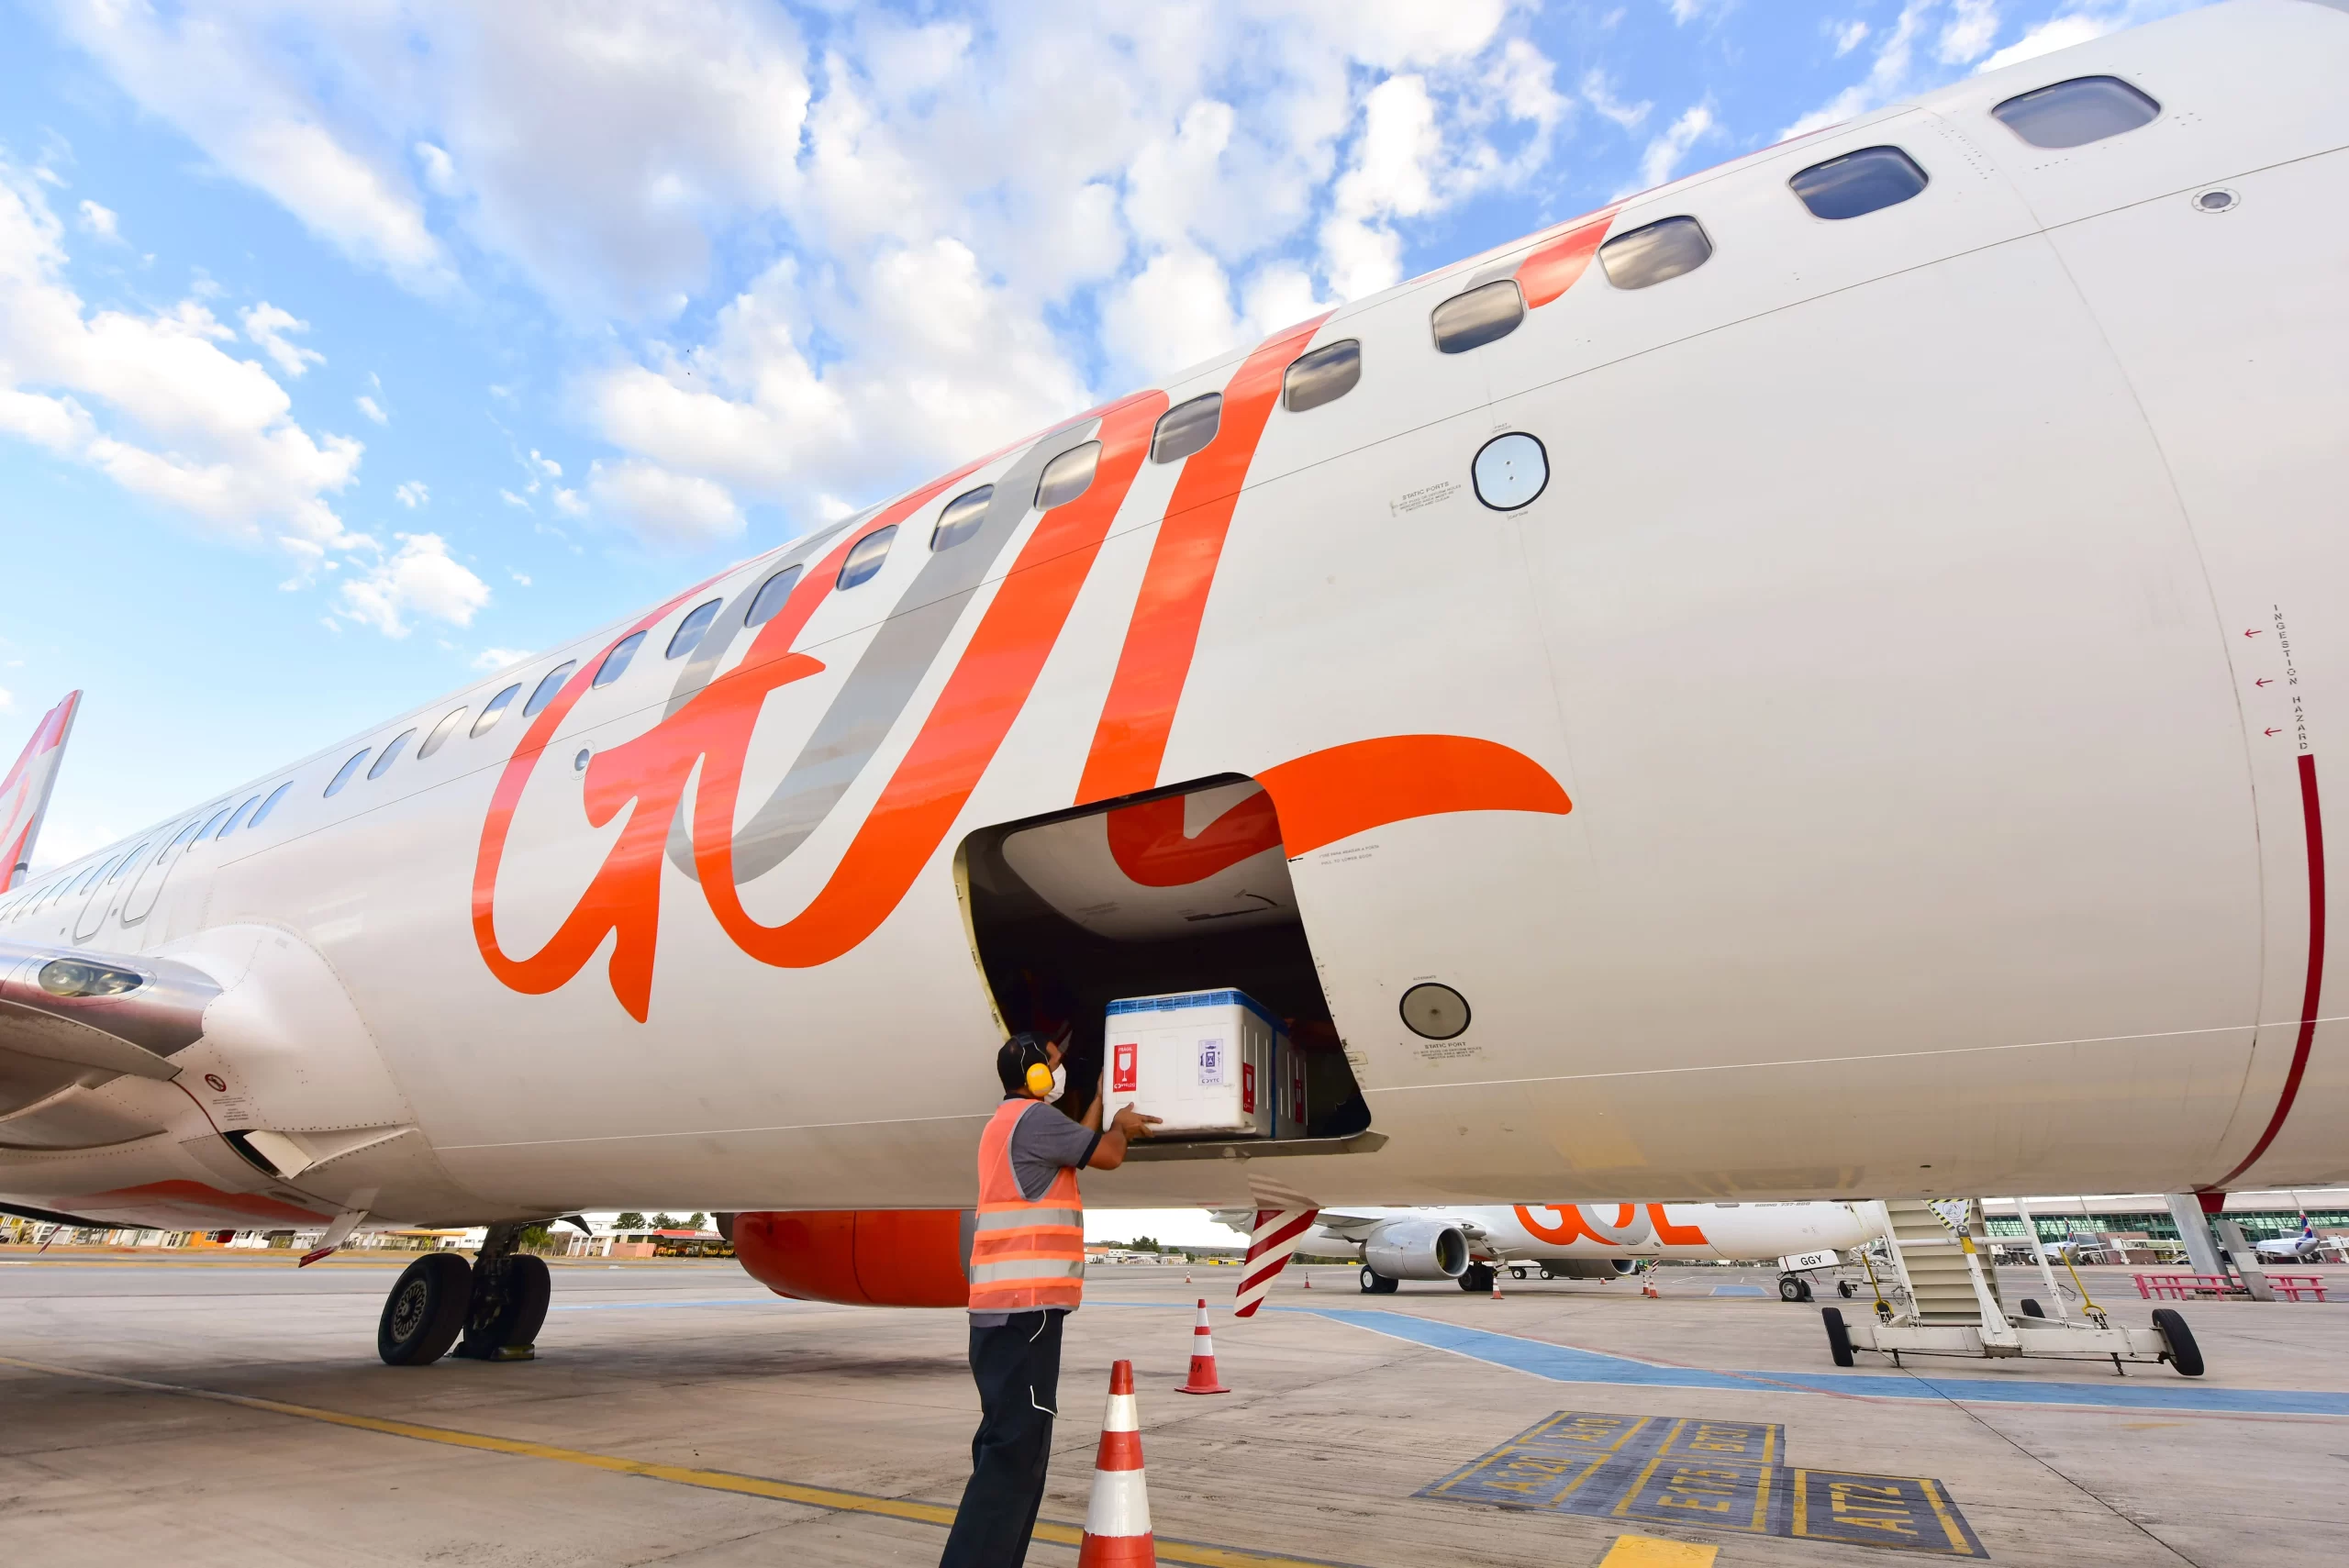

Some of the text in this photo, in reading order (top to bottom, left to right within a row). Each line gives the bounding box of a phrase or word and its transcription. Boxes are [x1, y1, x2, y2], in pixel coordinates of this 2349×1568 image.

[1402, 481, 1449, 500] STATIC PORTS
[2274, 604, 2308, 750] INGESTION HAZARD
[1800, 1254, 1822, 1265] GGY
[1688, 1425, 1750, 1452] B737
[1482, 1455, 1573, 1495] A320
[1656, 1467, 1741, 1513] E175
[1829, 1483, 1919, 1536] AT72
